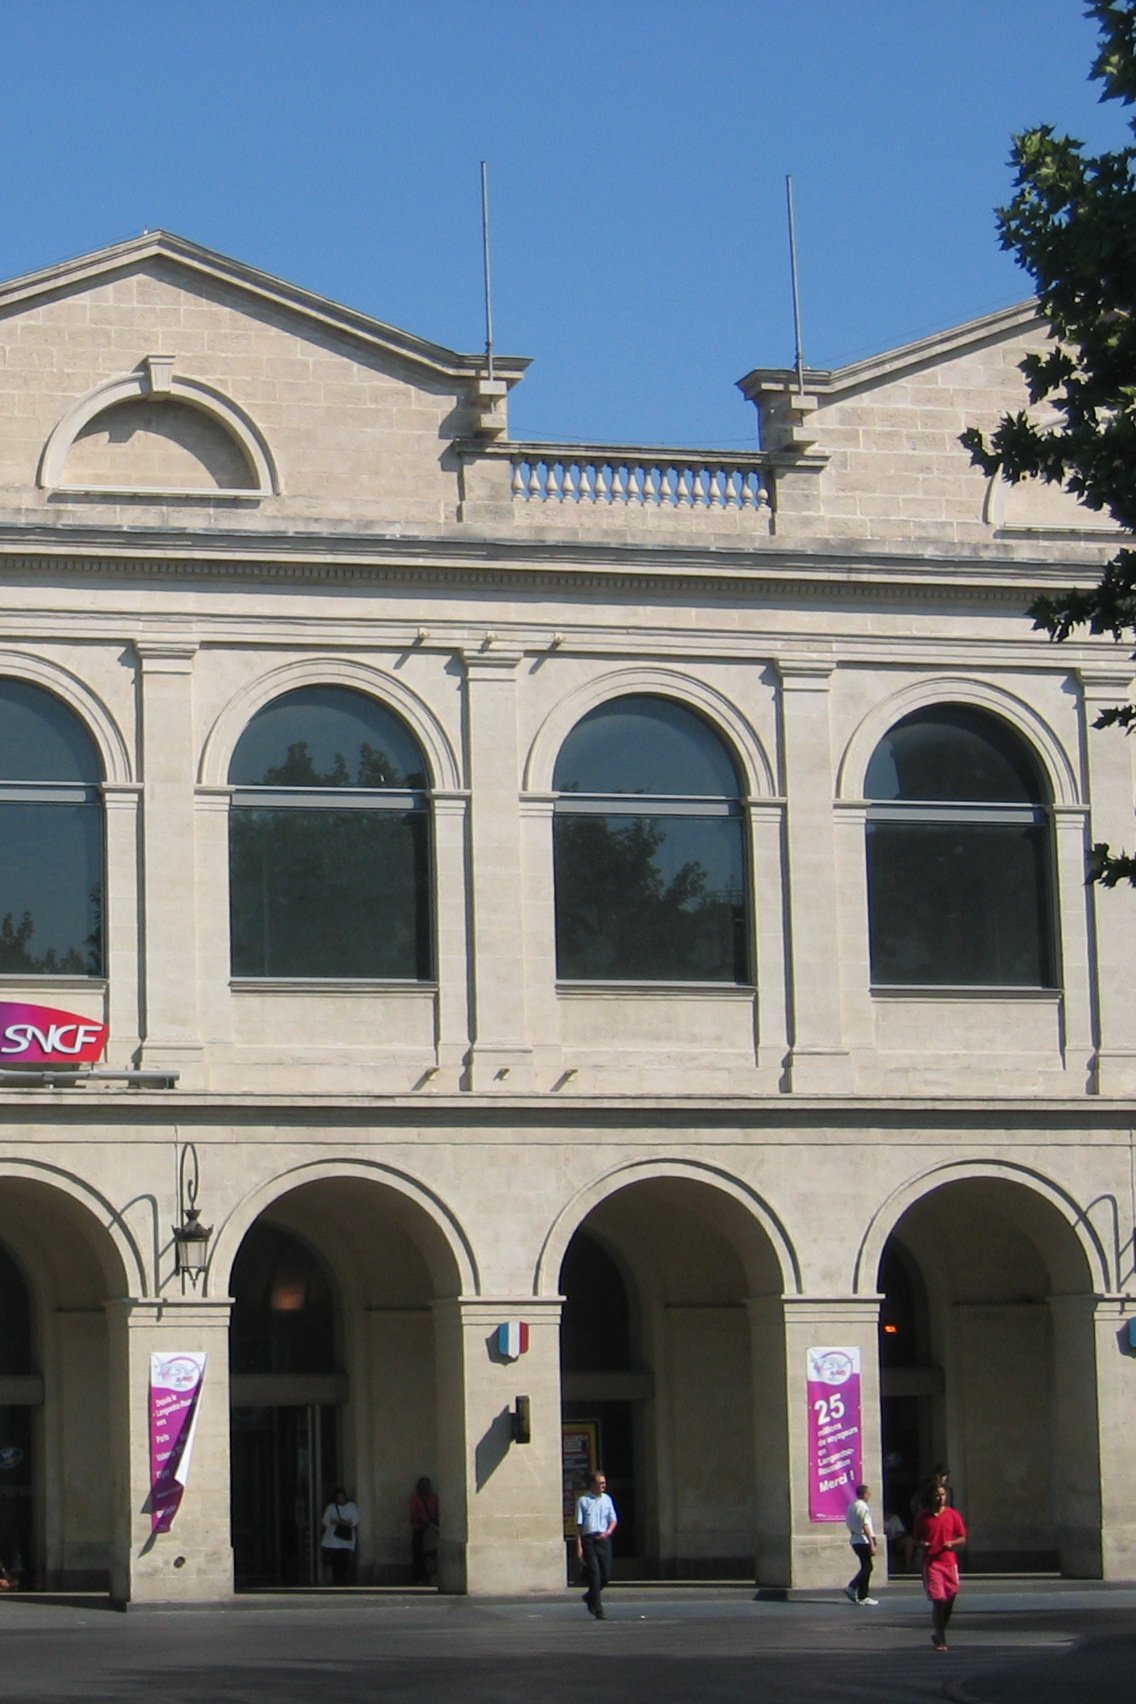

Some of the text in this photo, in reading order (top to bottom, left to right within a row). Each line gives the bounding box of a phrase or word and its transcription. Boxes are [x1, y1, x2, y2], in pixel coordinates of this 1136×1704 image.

[0, 1024, 103, 1054] SNCF
[814, 1393, 844, 1426] 25
[819, 1472, 848, 1492] Merci
